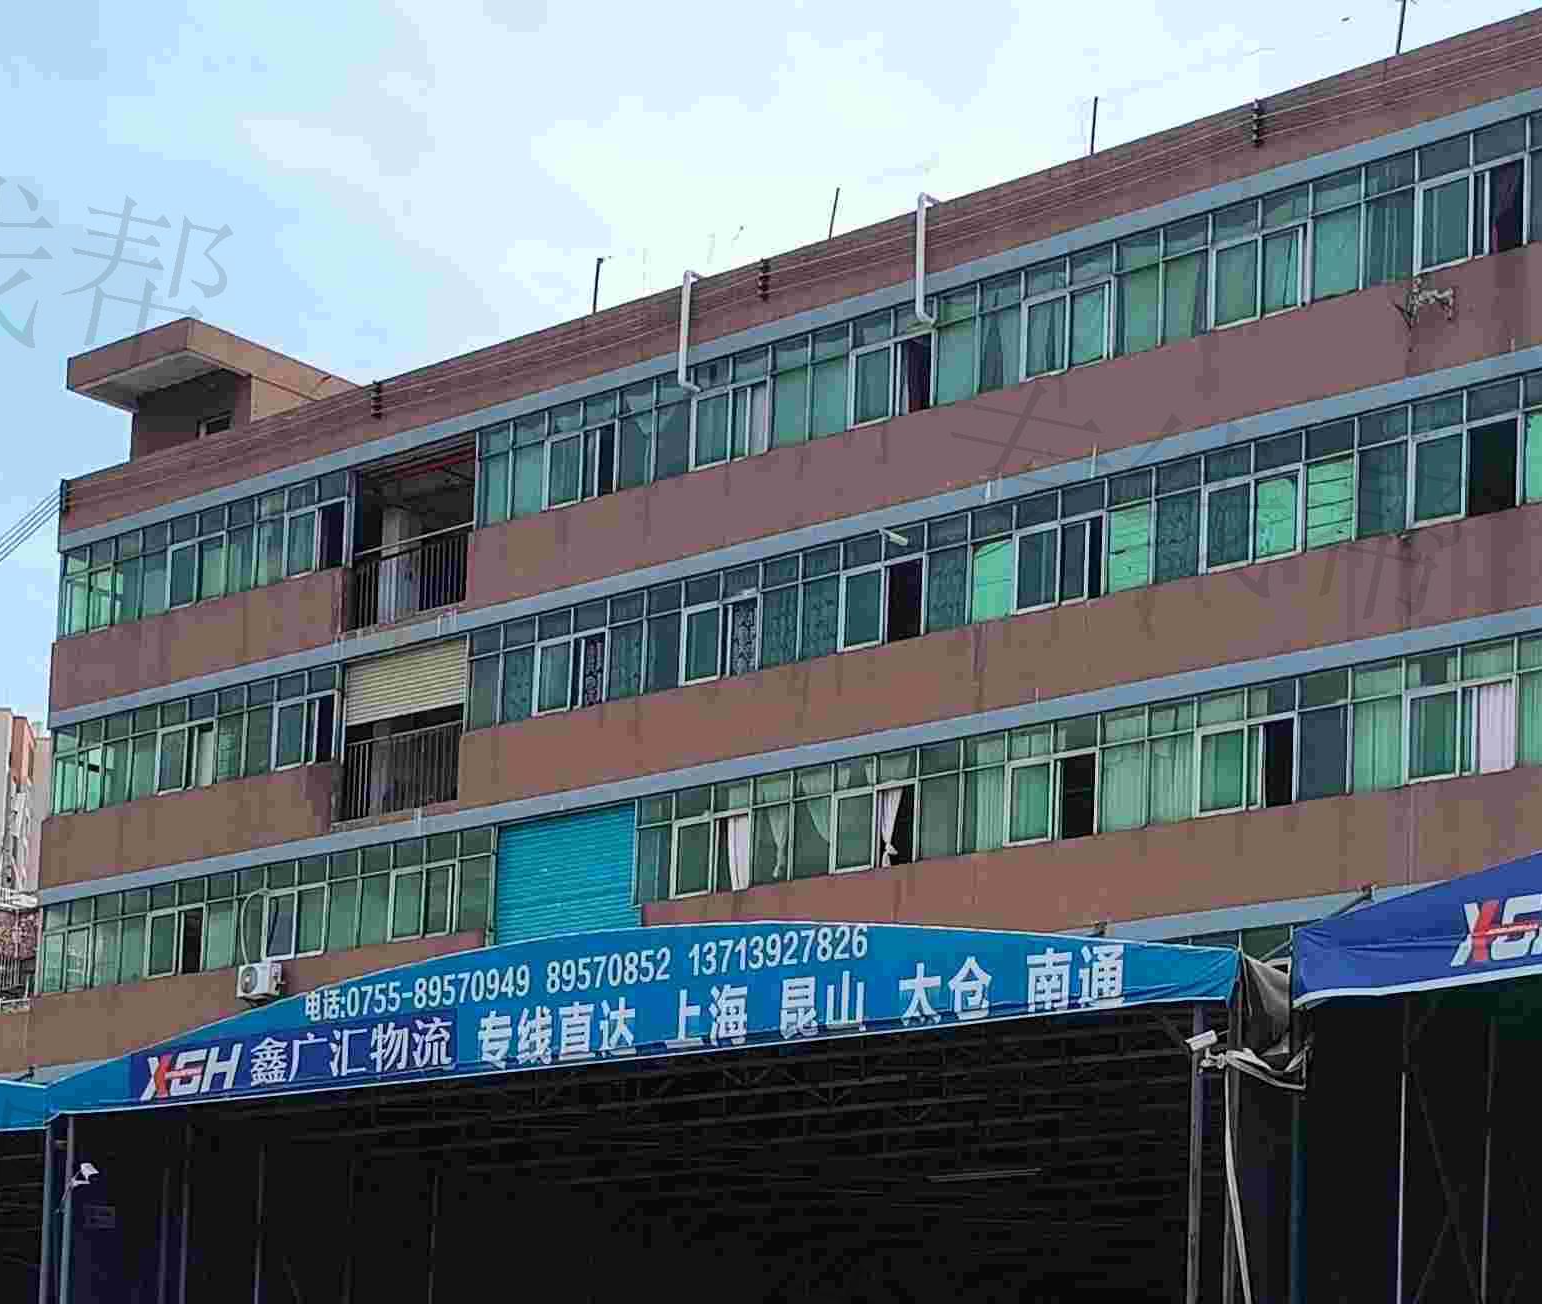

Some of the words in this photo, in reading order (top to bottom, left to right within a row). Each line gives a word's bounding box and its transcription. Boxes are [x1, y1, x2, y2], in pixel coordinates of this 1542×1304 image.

[545, 946, 671, 993] 89570852
[688, 925, 869, 977] 13713927826
[249, 1016, 454, 1087] 鑫广汇物流
[476, 996, 637, 1068] 专线直达
[665, 984, 749, 1049] 上海
[779, 970, 867, 1040] 昆山
[898, 955, 991, 1026] 太仓
[1025, 944, 1125, 1013] 南通
